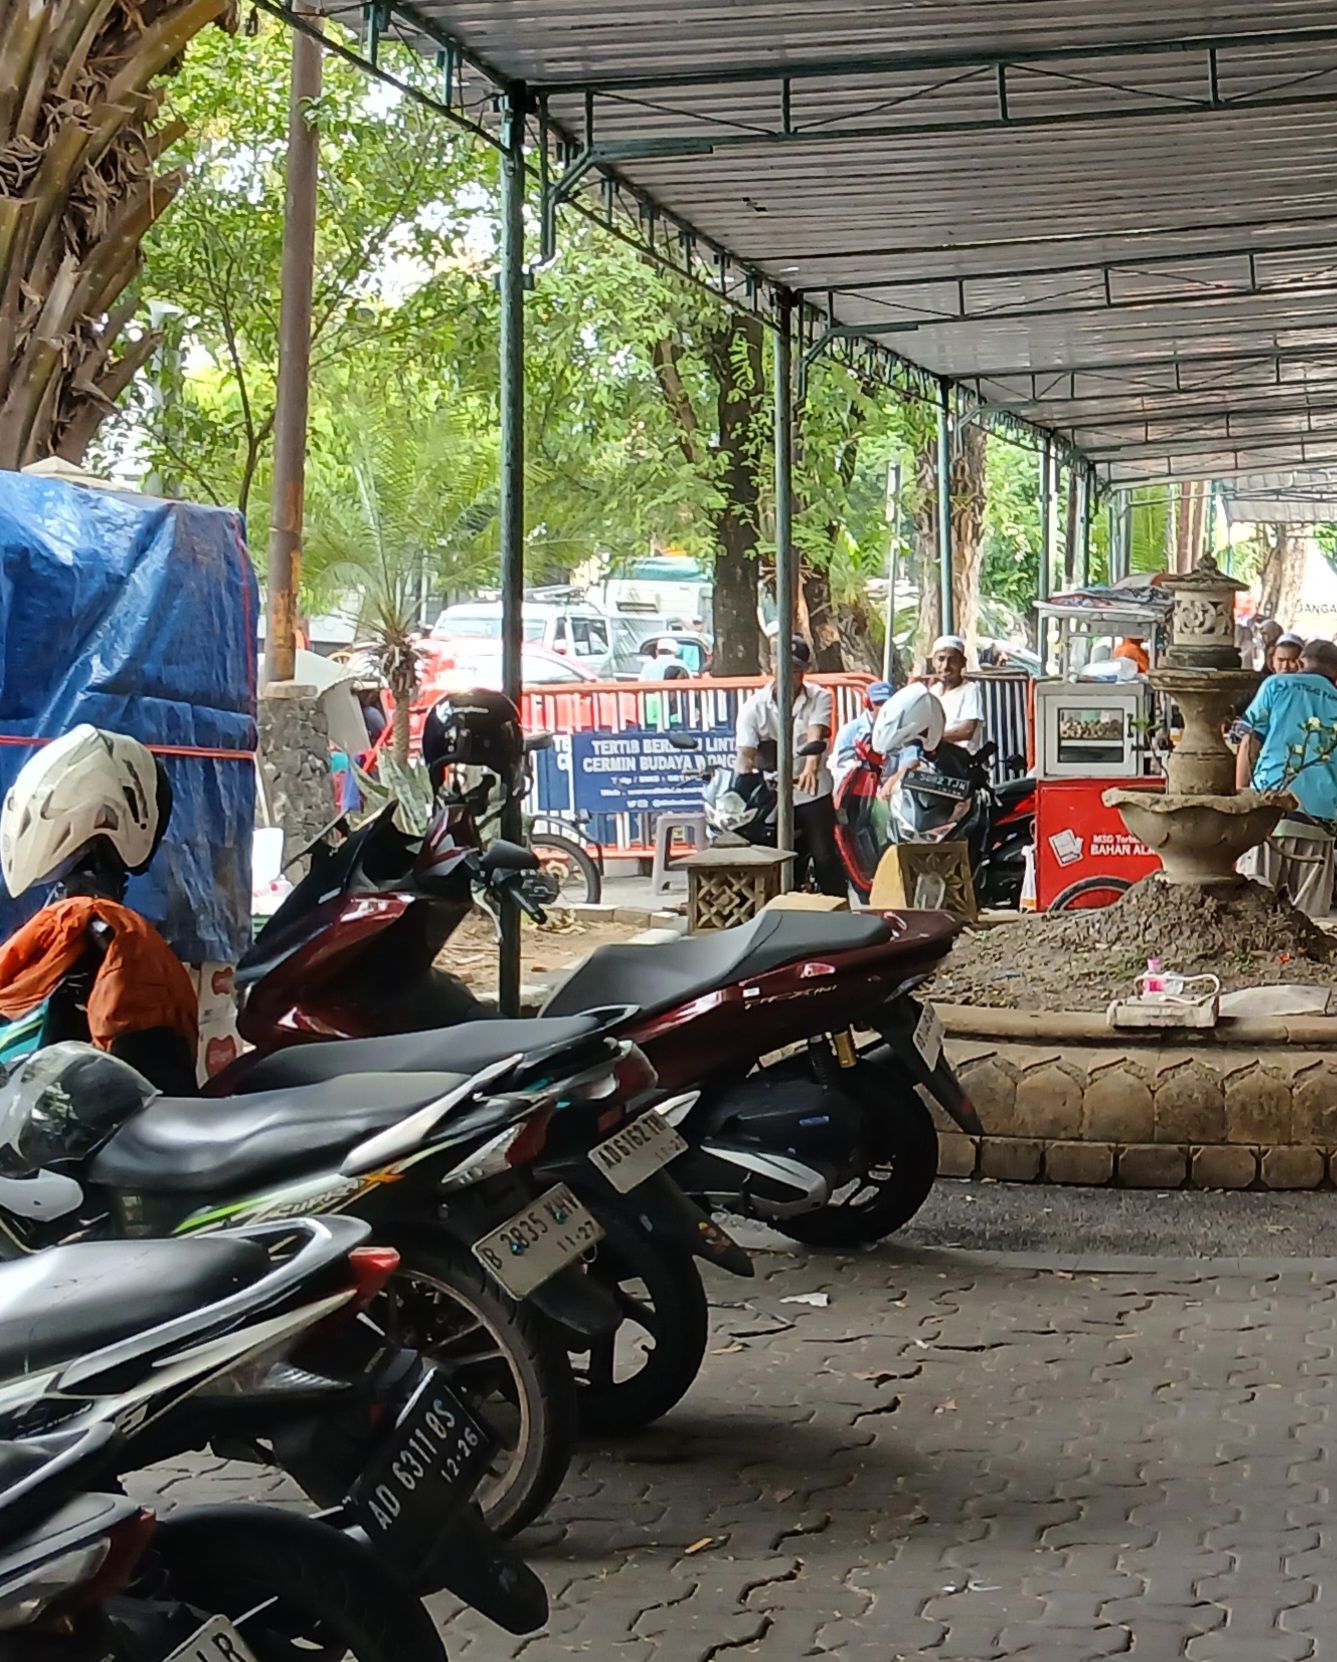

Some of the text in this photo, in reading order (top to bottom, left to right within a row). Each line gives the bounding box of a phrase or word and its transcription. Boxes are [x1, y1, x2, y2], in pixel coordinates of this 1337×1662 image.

[591, 739, 641, 755] TERTIB
[705, 737, 737, 752] LINT
[583, 755, 637, 772] CERMIN
[639, 754, 692, 771] BUDAYA
[1091, 844, 1131, 856] BAHAN
[482, 1248, 503, 1270] B
[368, 1484, 401, 1530] AD
[392, 1428, 438, 1491] 6311
